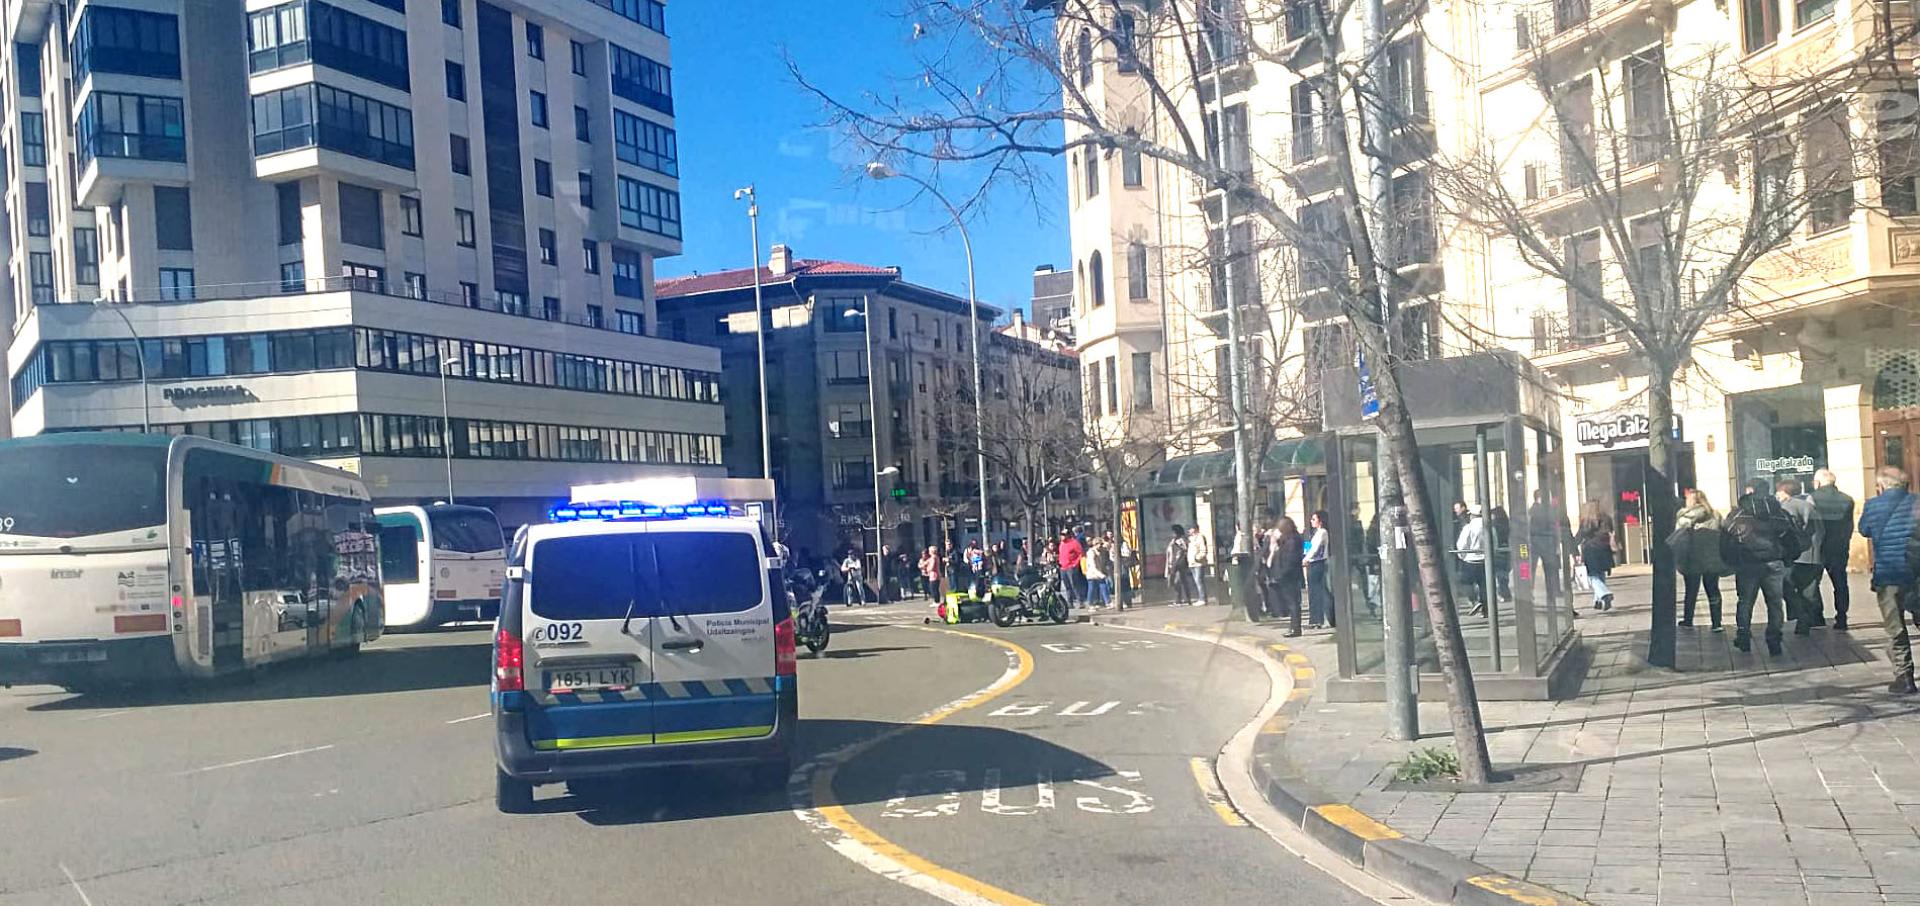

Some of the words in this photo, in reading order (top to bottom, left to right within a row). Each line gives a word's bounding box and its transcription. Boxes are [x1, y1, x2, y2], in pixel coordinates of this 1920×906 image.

[1577, 415, 1678, 443] MegaCalz
[1757, 455, 1813, 471] MegaCalzado
[733, 618, 770, 626] Municipal
[547, 623, 583, 641] 092
[1040, 640, 1171, 653] BS
[555, 671, 592, 687] 1851
[600, 669, 631, 685] LYK
[880, 769, 1156, 816] BUS
